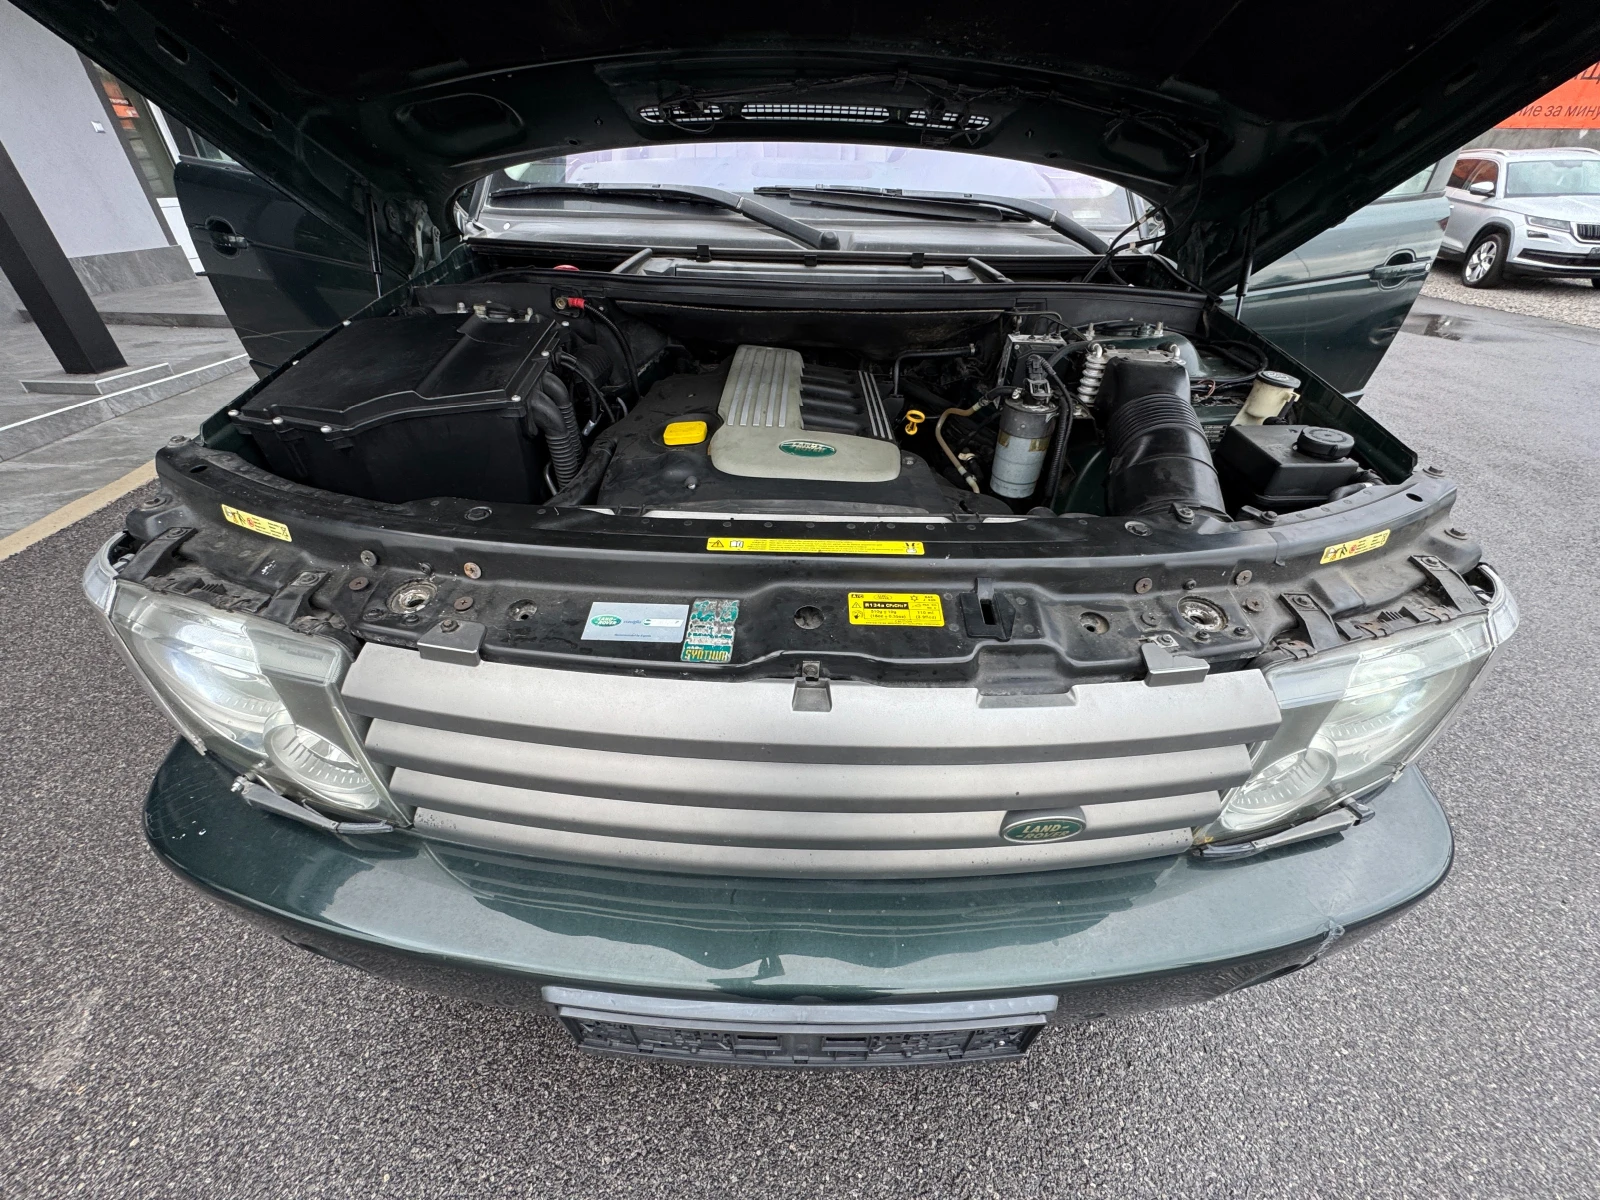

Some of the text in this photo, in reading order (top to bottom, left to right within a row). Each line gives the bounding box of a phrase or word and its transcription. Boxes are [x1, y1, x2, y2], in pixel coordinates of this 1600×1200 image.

[1544, 105, 1563, 117] за
[1022, 824, 1062, 834] LAND
[1023, 830, 1070, 839] ROVER
